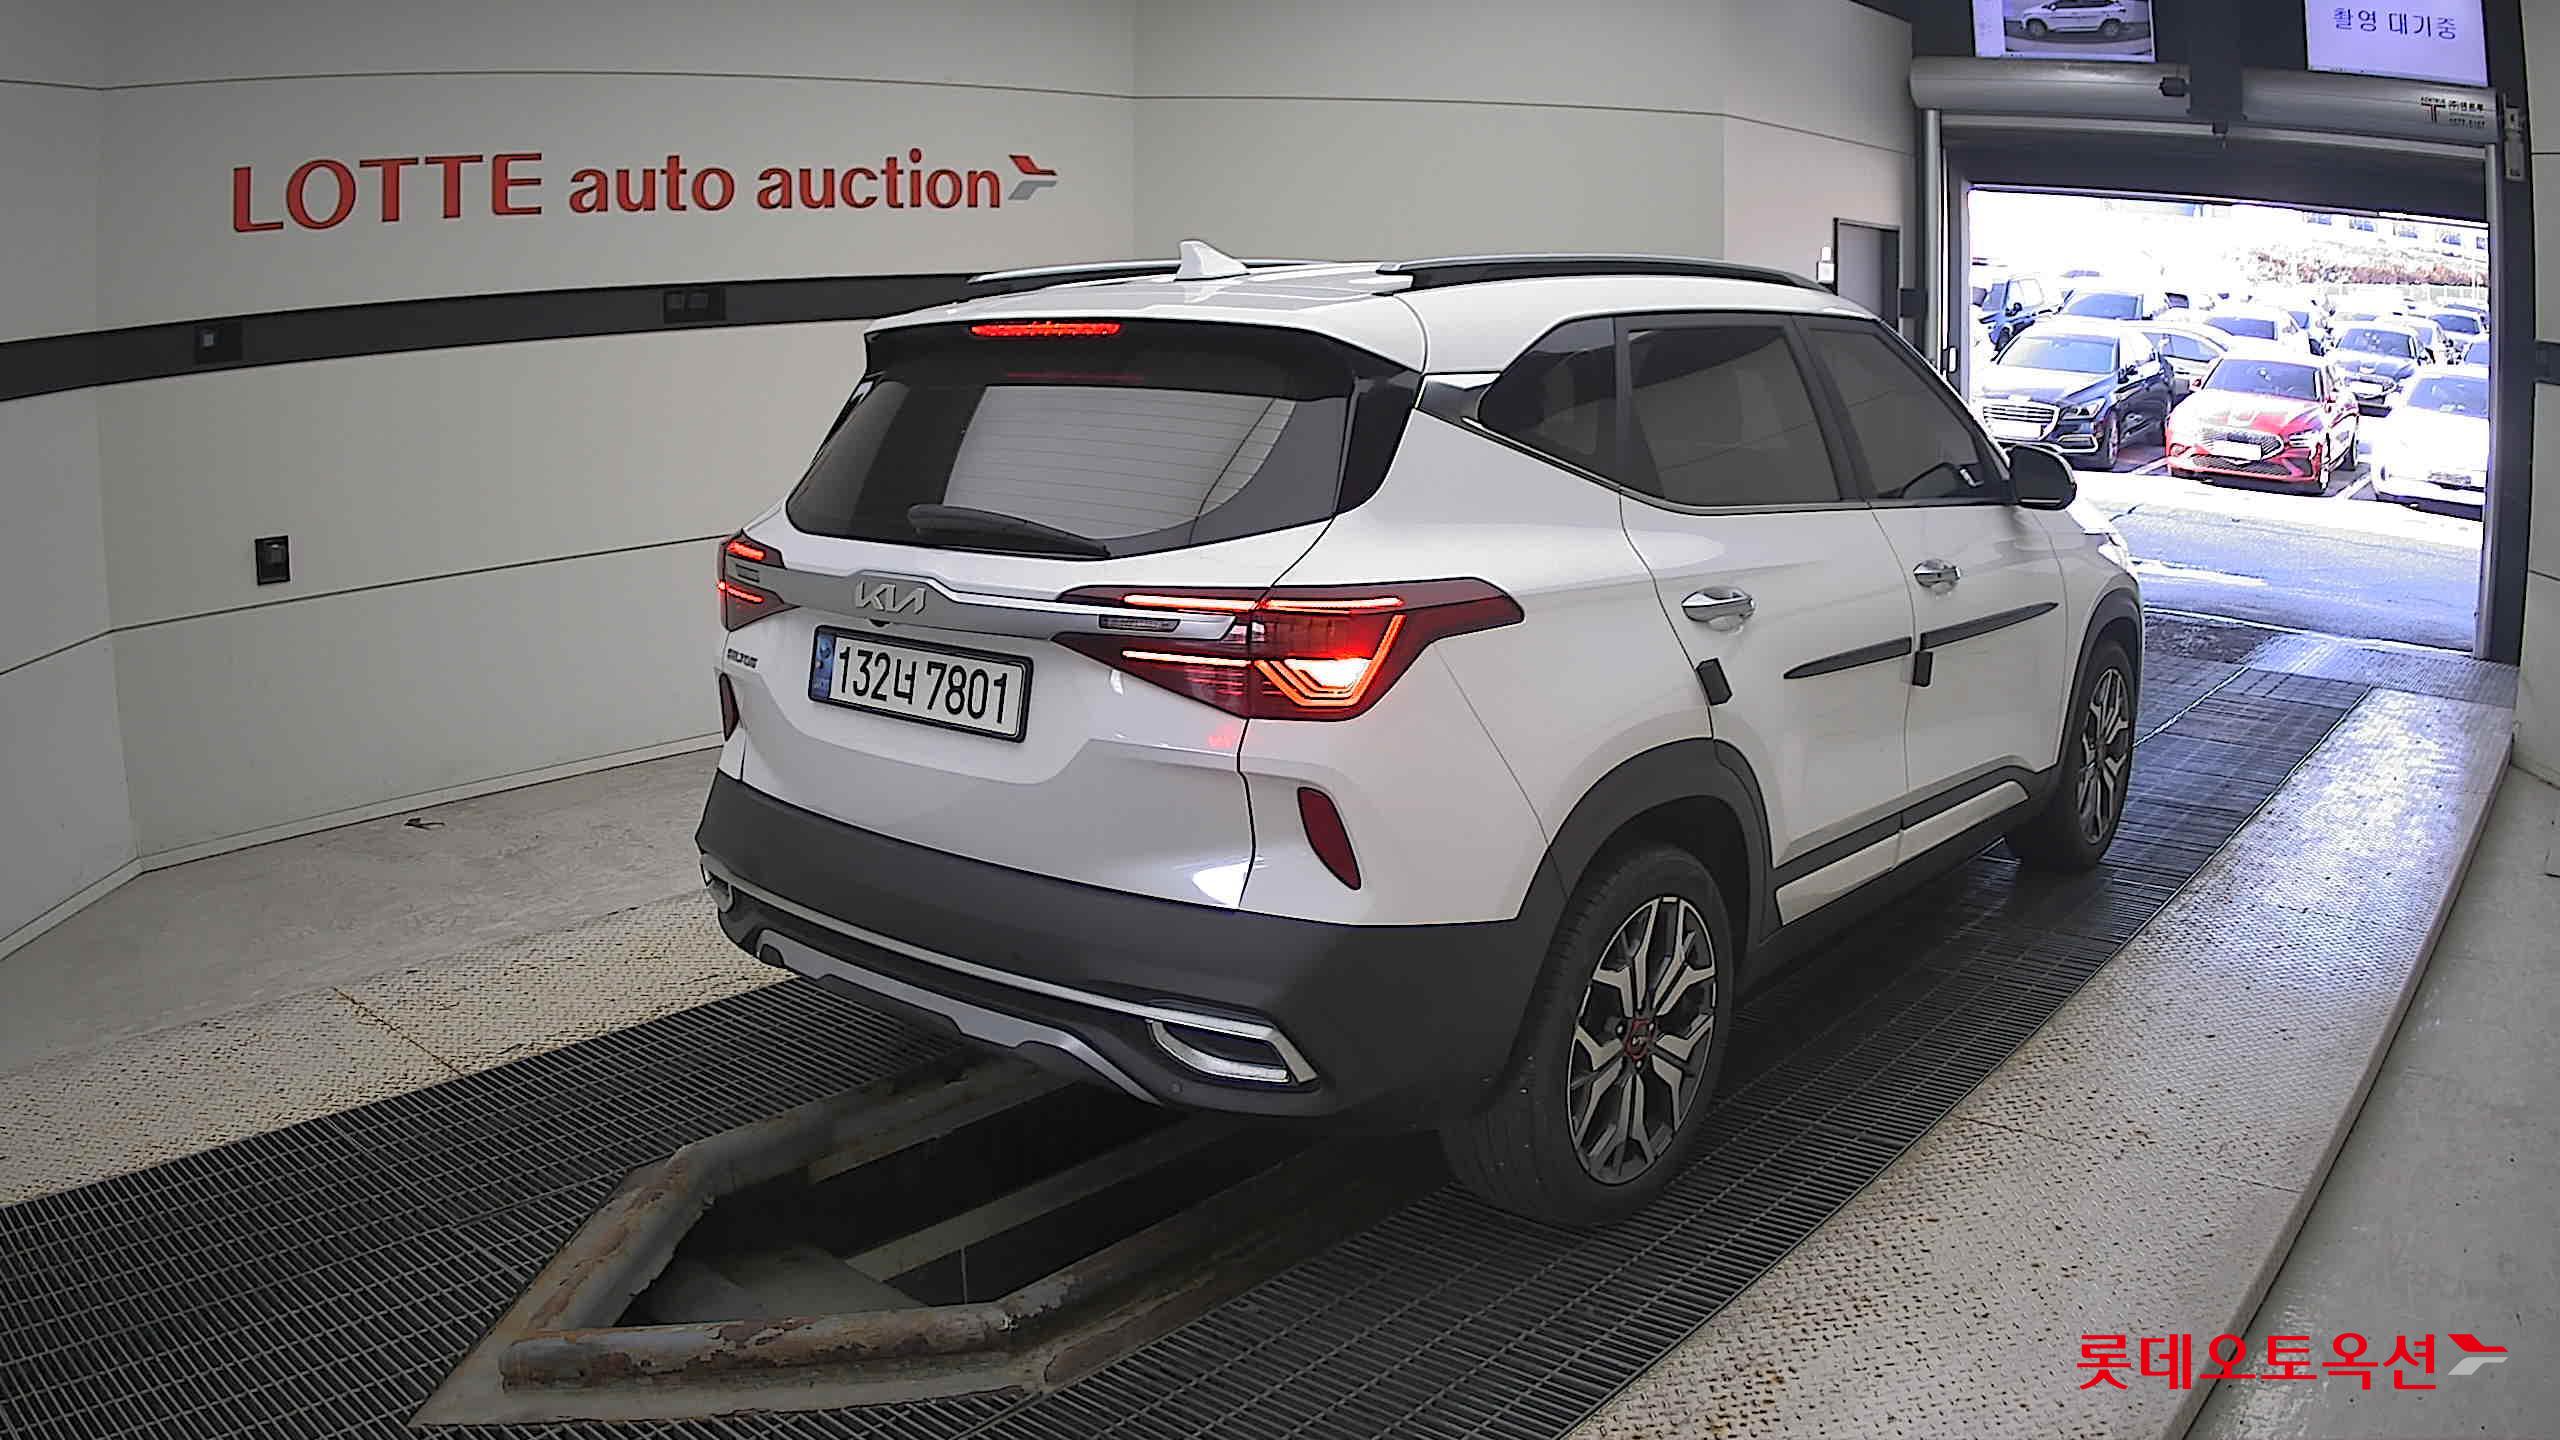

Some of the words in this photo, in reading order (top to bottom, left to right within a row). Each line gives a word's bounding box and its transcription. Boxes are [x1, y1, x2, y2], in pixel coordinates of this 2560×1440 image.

[2334, 7, 2377, 32] 촬영
[2388, 12, 2457, 40] 대기중
[233, 153, 542, 232] LOTTE
[569, 156, 735, 213] auto
[757, 148, 1000, 210] auction
[855, 579, 926, 615] KIA
